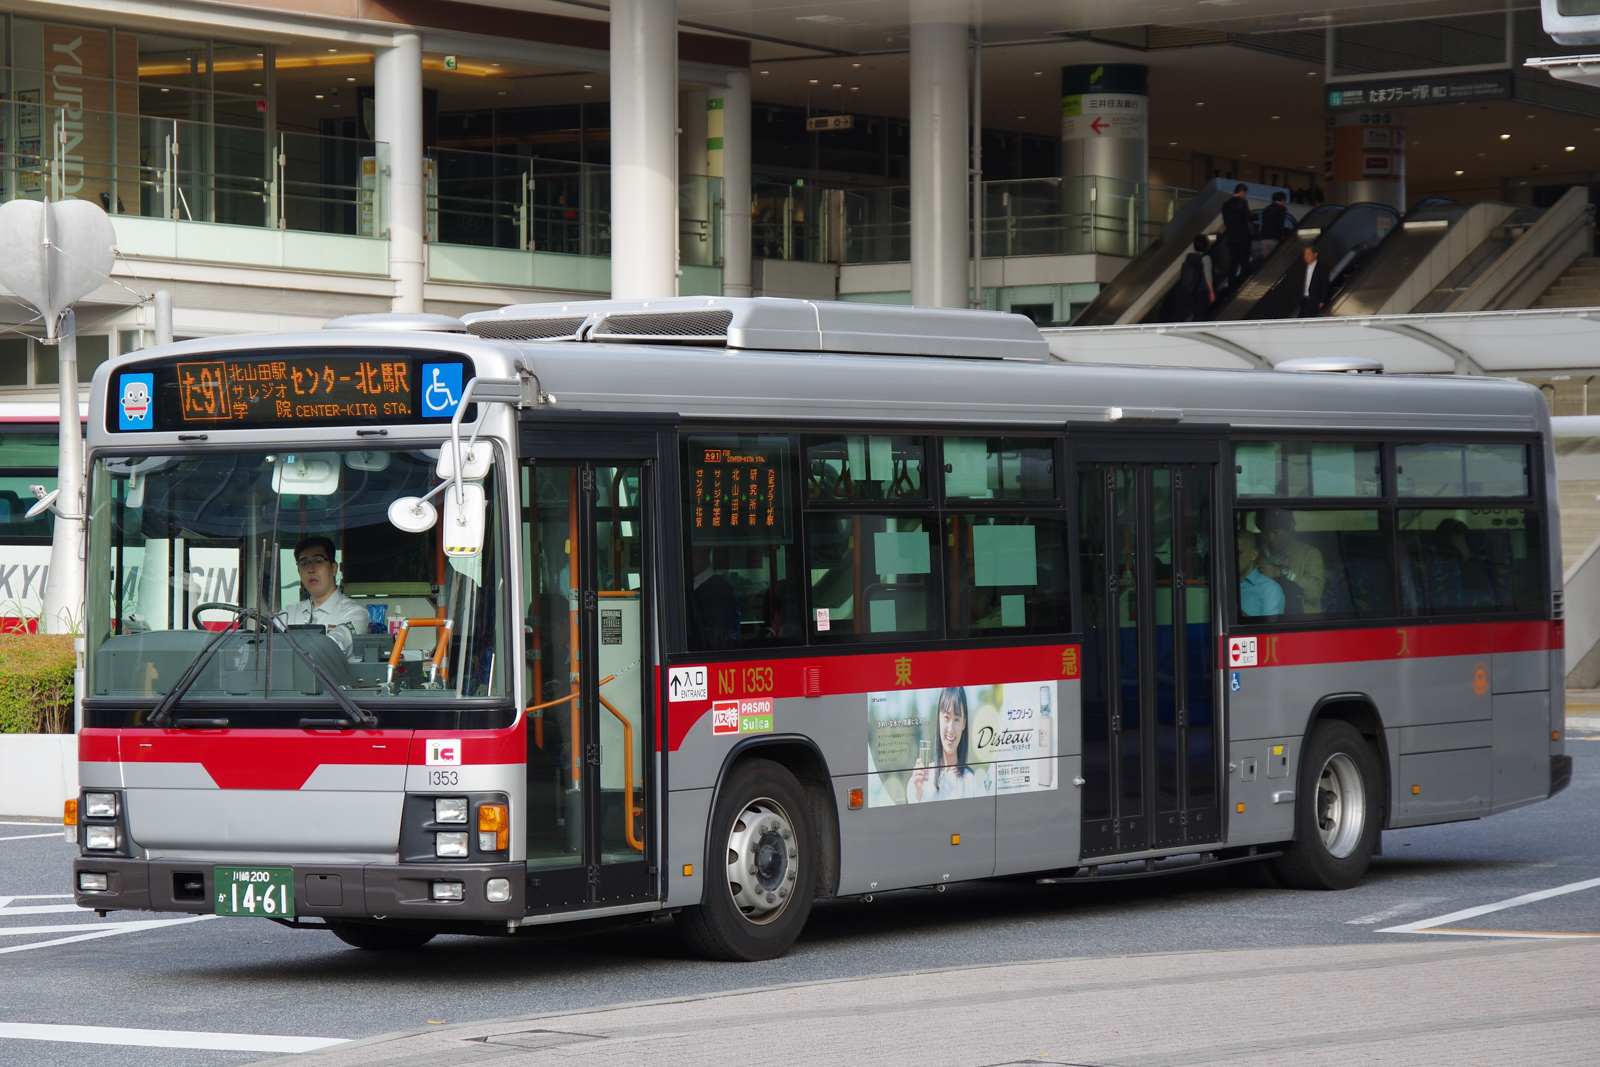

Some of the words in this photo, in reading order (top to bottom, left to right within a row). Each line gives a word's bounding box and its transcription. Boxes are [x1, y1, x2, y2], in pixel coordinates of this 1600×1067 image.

[1369, 85, 1430, 103] たまプラーザ駅
[1090, 99, 1139, 109] 三井住友銀行
[53, 36, 84, 200] YURIND
[228, 362, 288, 381] 北山田駅
[290, 362, 410, 394] センター北駅
[182, 367, 226, 414] た91
[232, 382, 288, 399] サレジオ
[295, 403, 378, 417] CENTER-KITA
[383, 402, 412, 415] STA.
[695, 469, 704, 527] センター北駅
[712, 469, 721, 526] サレジオ学院
[730, 468, 740, 526] 北山田駅
[748, 468, 758, 525] 研究所前
[1241, 640, 1256, 654] 出口
[1243, 656, 1254, 664] EXIT
[684, 671, 704, 687] 入口
[718, 669, 736, 695] NJ
[742, 667, 774, 693] 1353
[681, 688, 706, 699] ENTRANCE
[741, 701, 771, 714] PASMO
[1007, 708, 1033, 720] サニクリーン
[742, 717, 770, 731] Suica
[977, 726, 1034, 749] Disteau
[428, 771, 459, 786] 1353
[231, 883, 287, 914] 14-61
